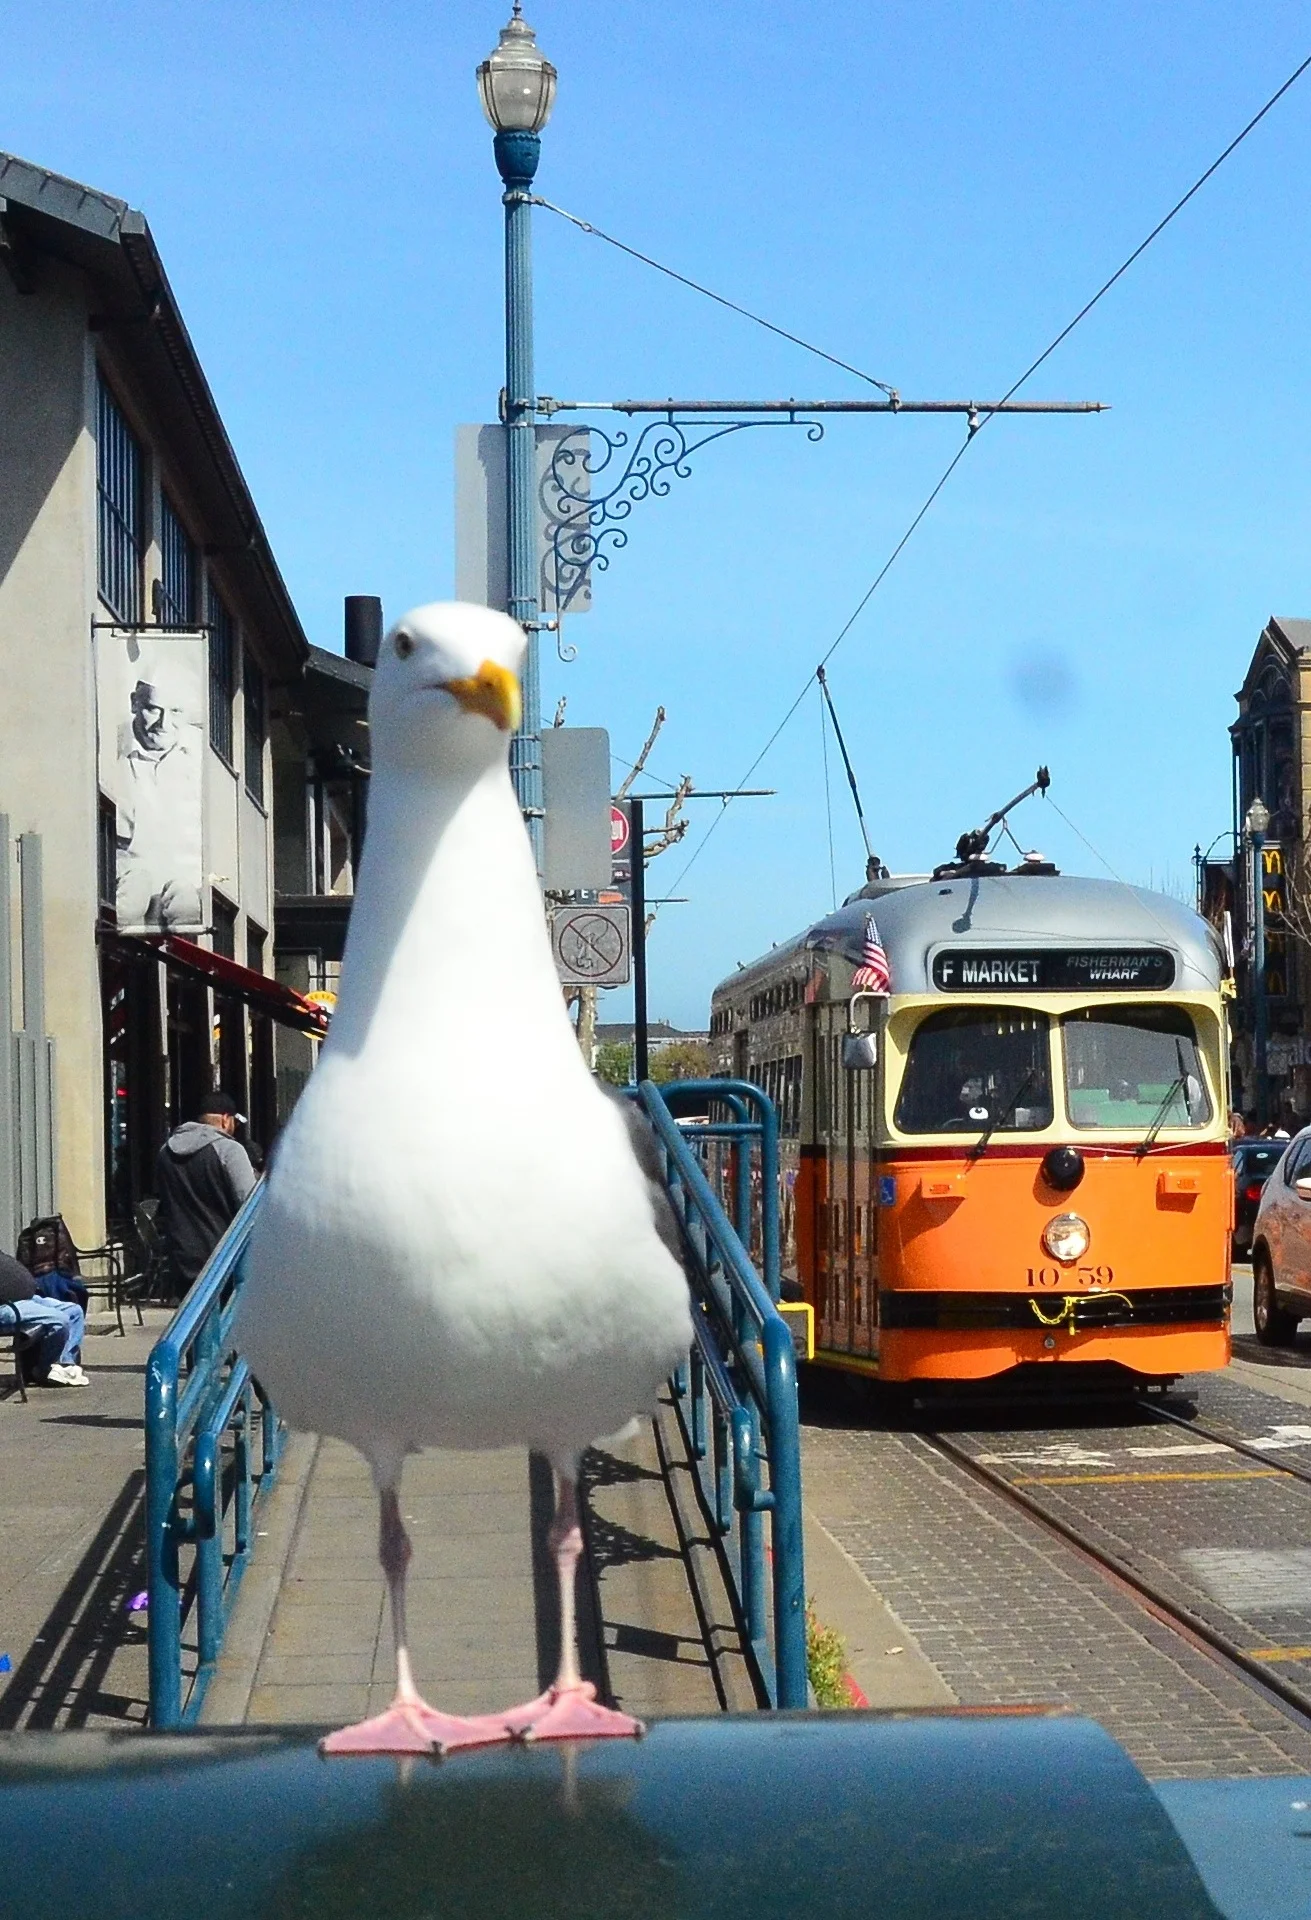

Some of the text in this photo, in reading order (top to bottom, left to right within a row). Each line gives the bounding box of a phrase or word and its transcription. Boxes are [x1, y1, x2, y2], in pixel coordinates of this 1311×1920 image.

[1066, 956, 1163, 968] FISHERMAN'S
[942, 960, 1041, 983] F MARKET
[1089, 968, 1140, 981] WHARF
